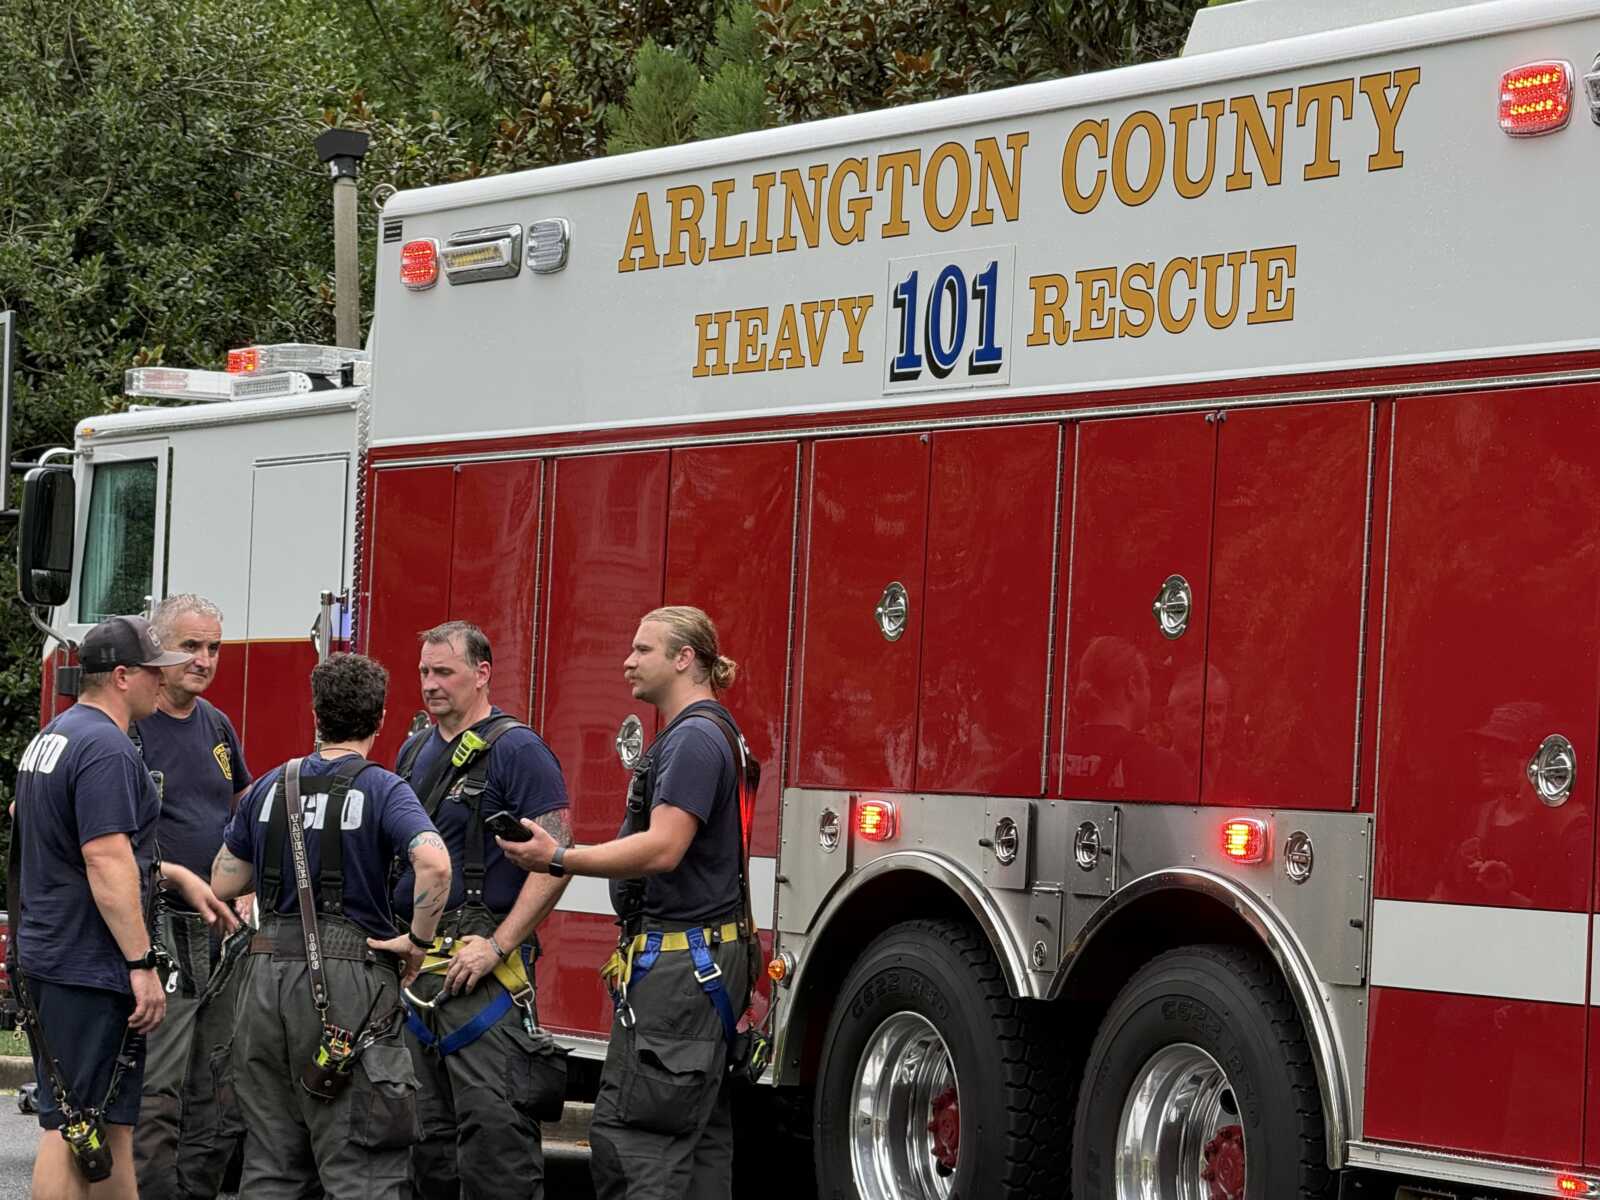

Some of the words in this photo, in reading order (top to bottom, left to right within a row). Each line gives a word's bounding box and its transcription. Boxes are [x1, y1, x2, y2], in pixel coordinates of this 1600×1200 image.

[618, 131, 1030, 274] ARLINGTON
[1061, 66, 1421, 215] COUNTY
[692, 294, 874, 378] HEAVY
[889, 260, 1004, 383] 101
[1026, 244, 1298, 347] RESCUE
